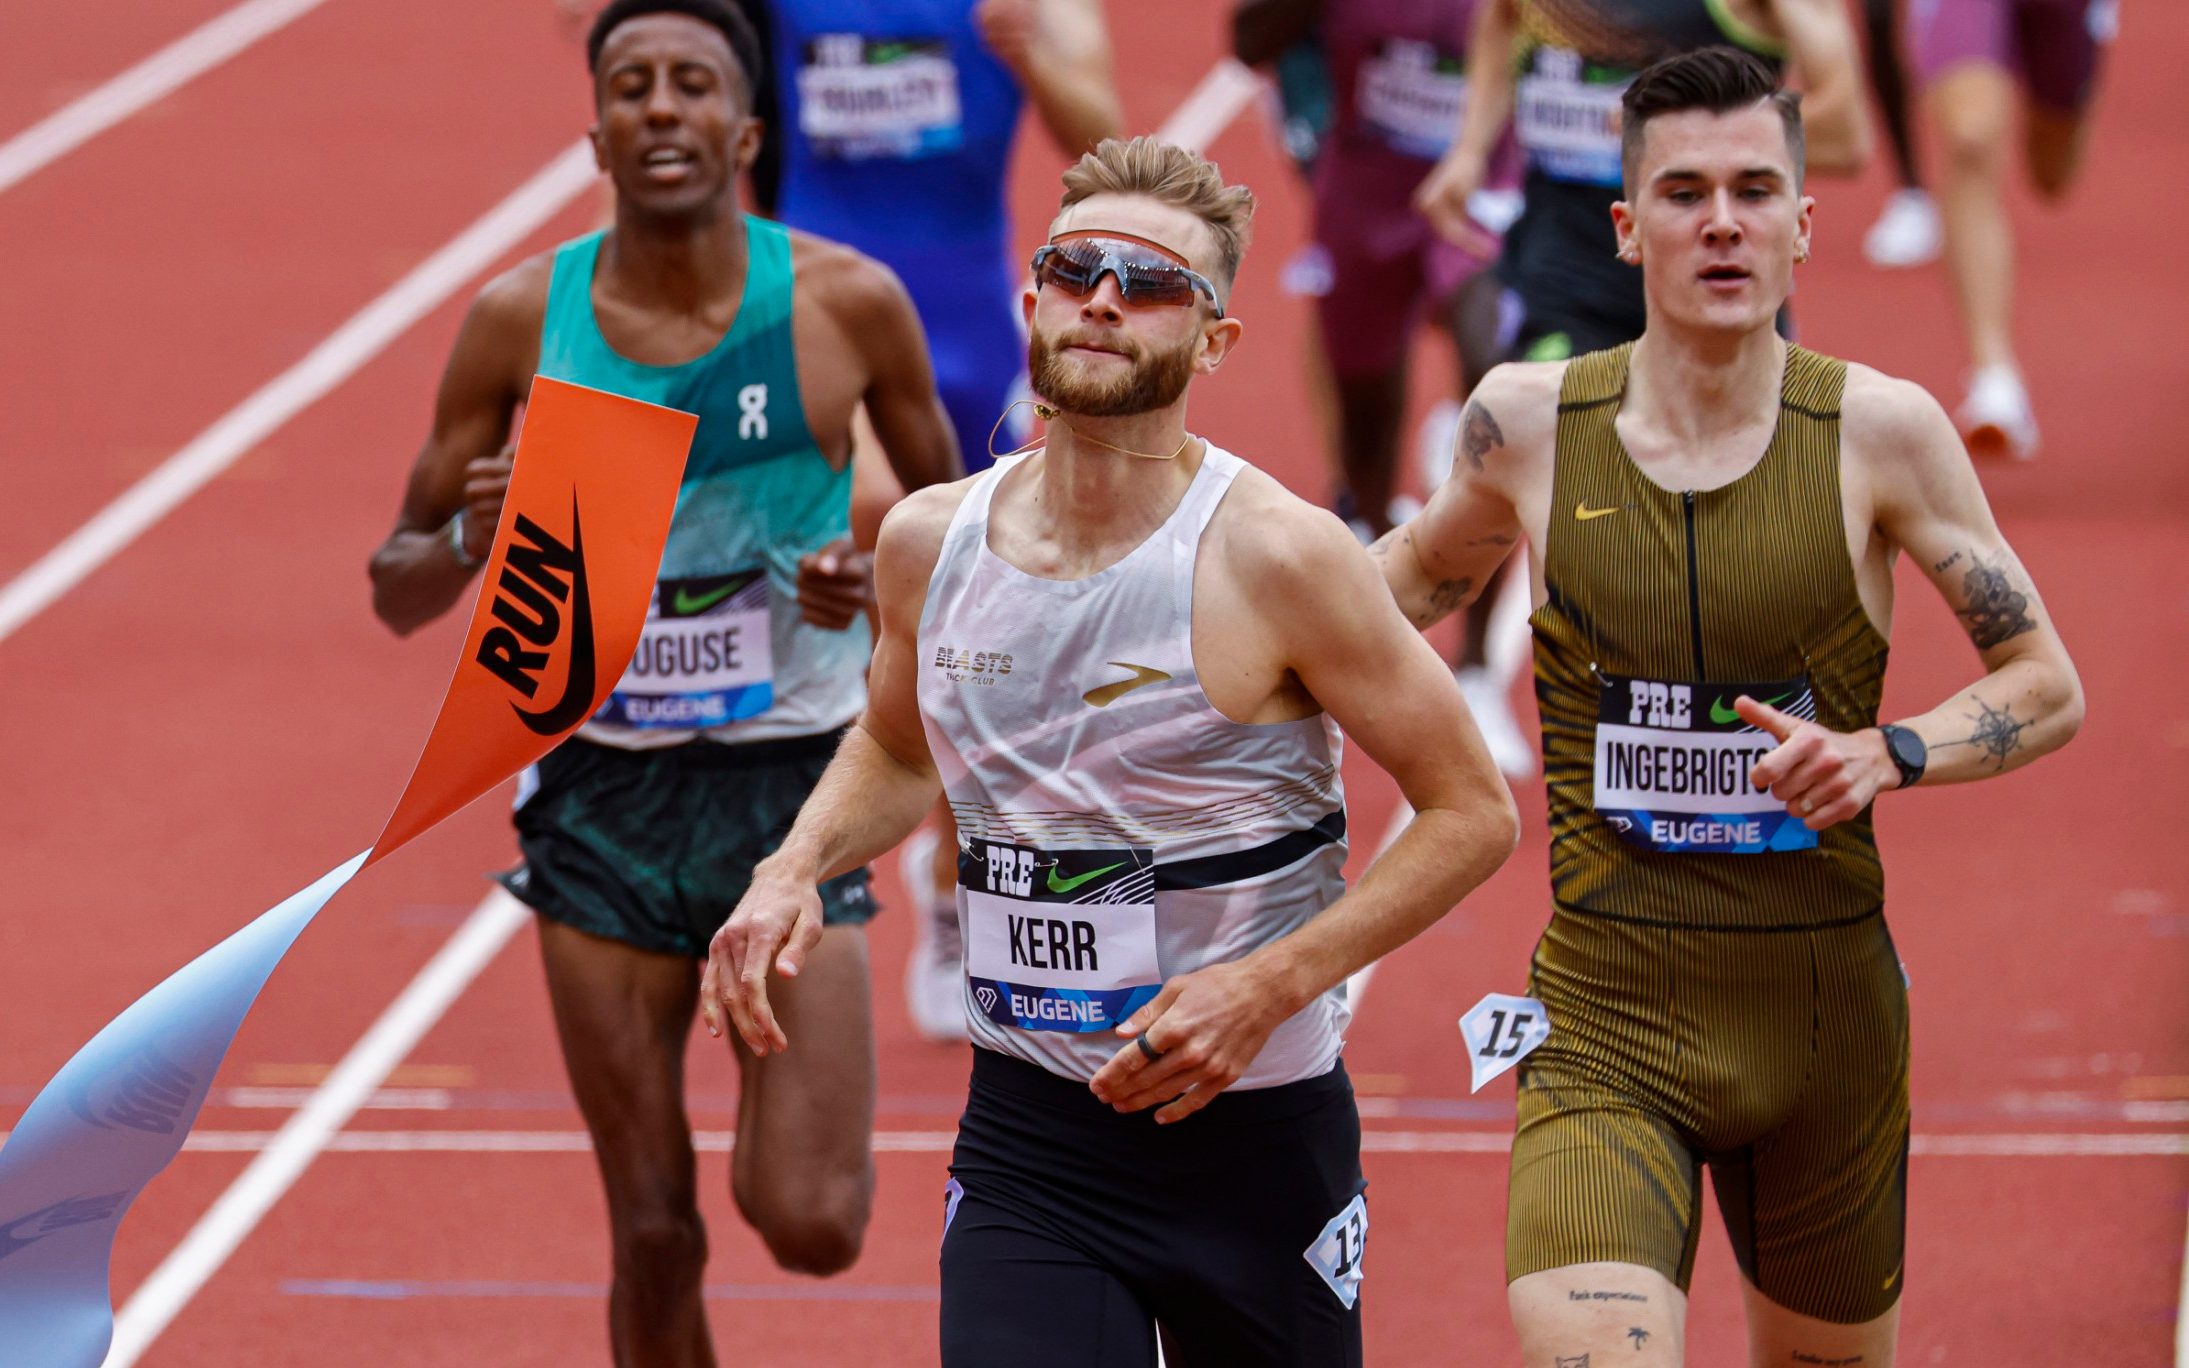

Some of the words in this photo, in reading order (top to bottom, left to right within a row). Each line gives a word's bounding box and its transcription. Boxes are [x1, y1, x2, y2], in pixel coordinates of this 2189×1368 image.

[476, 512, 573, 700] RUN
[633, 627, 743, 678] UGUSE
[625, 694, 728, 723] EUGENE
[1629, 680, 1692, 729] PRE
[1651, 820, 1761, 844] EUGENE
[986, 845, 1034, 898] PRE
[1008, 914, 1099, 971] KERR
[1011, 993, 1105, 1023] EUGENE
[1479, 1010, 1534, 1058] 15
